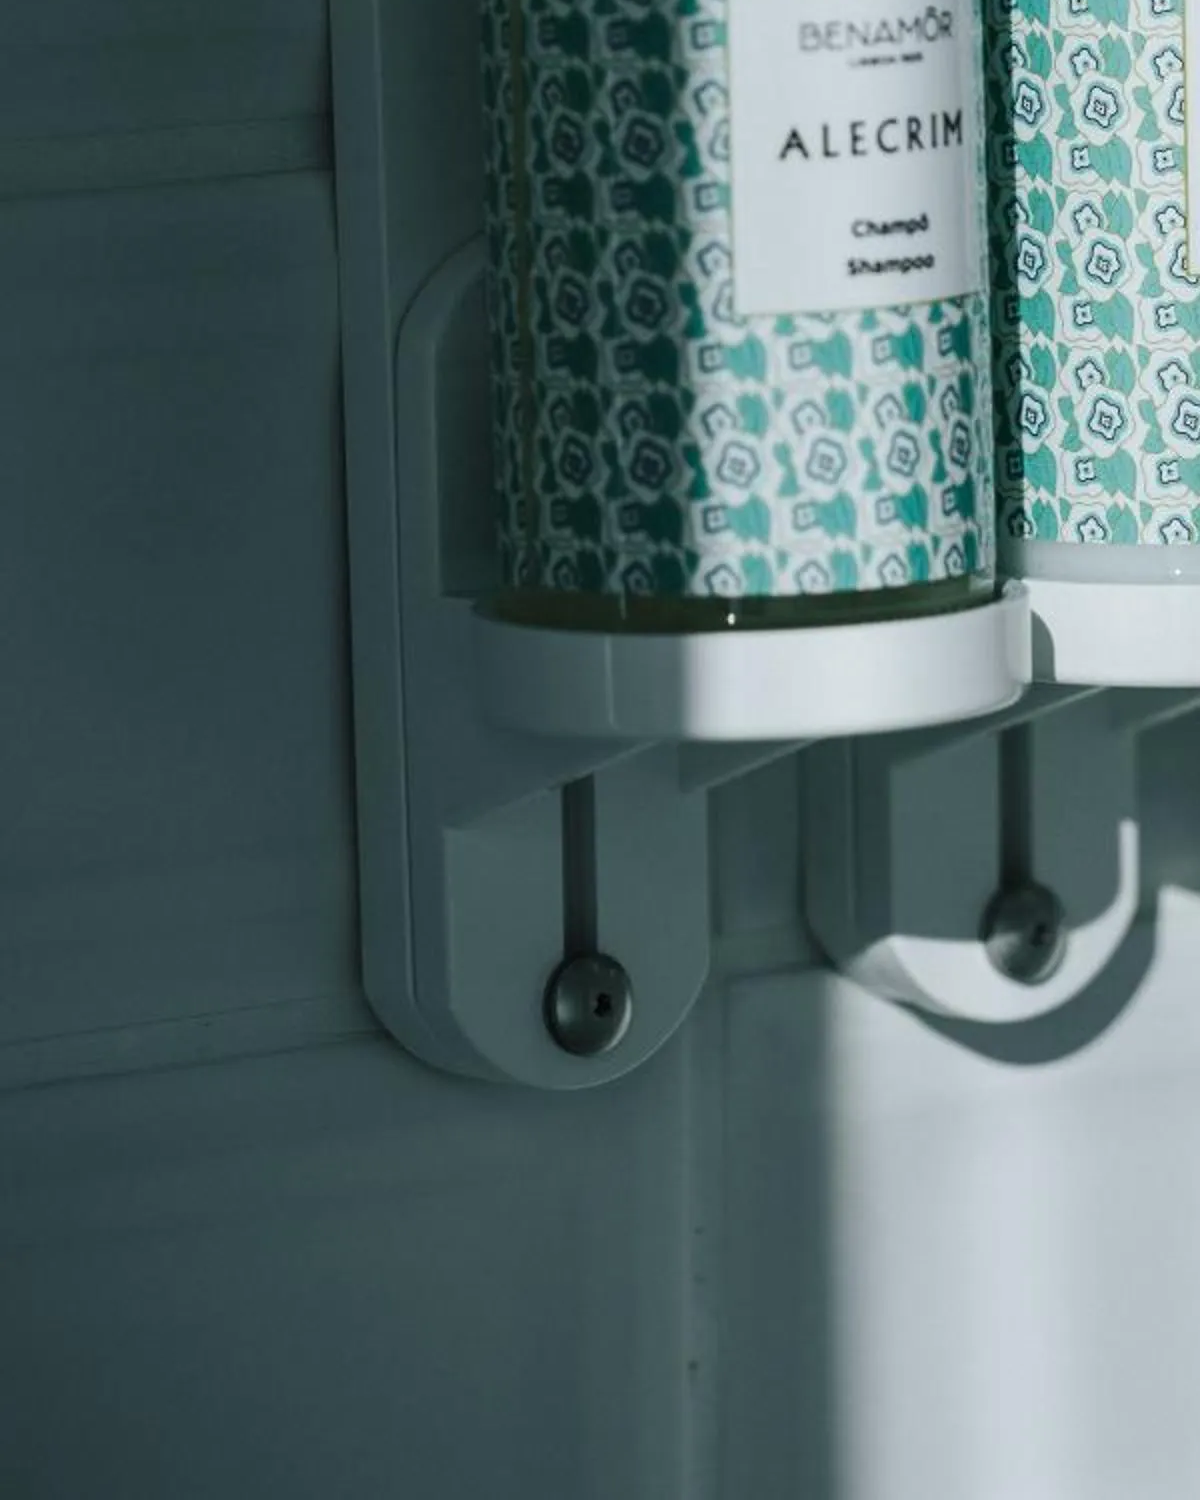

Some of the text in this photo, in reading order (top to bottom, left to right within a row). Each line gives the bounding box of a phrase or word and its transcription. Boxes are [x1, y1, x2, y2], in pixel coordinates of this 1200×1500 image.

[799, 5, 953, 52] BENAMÔR
[779, 108, 963, 160] ALECRIM
[847, 253, 935, 276] Shampoo
